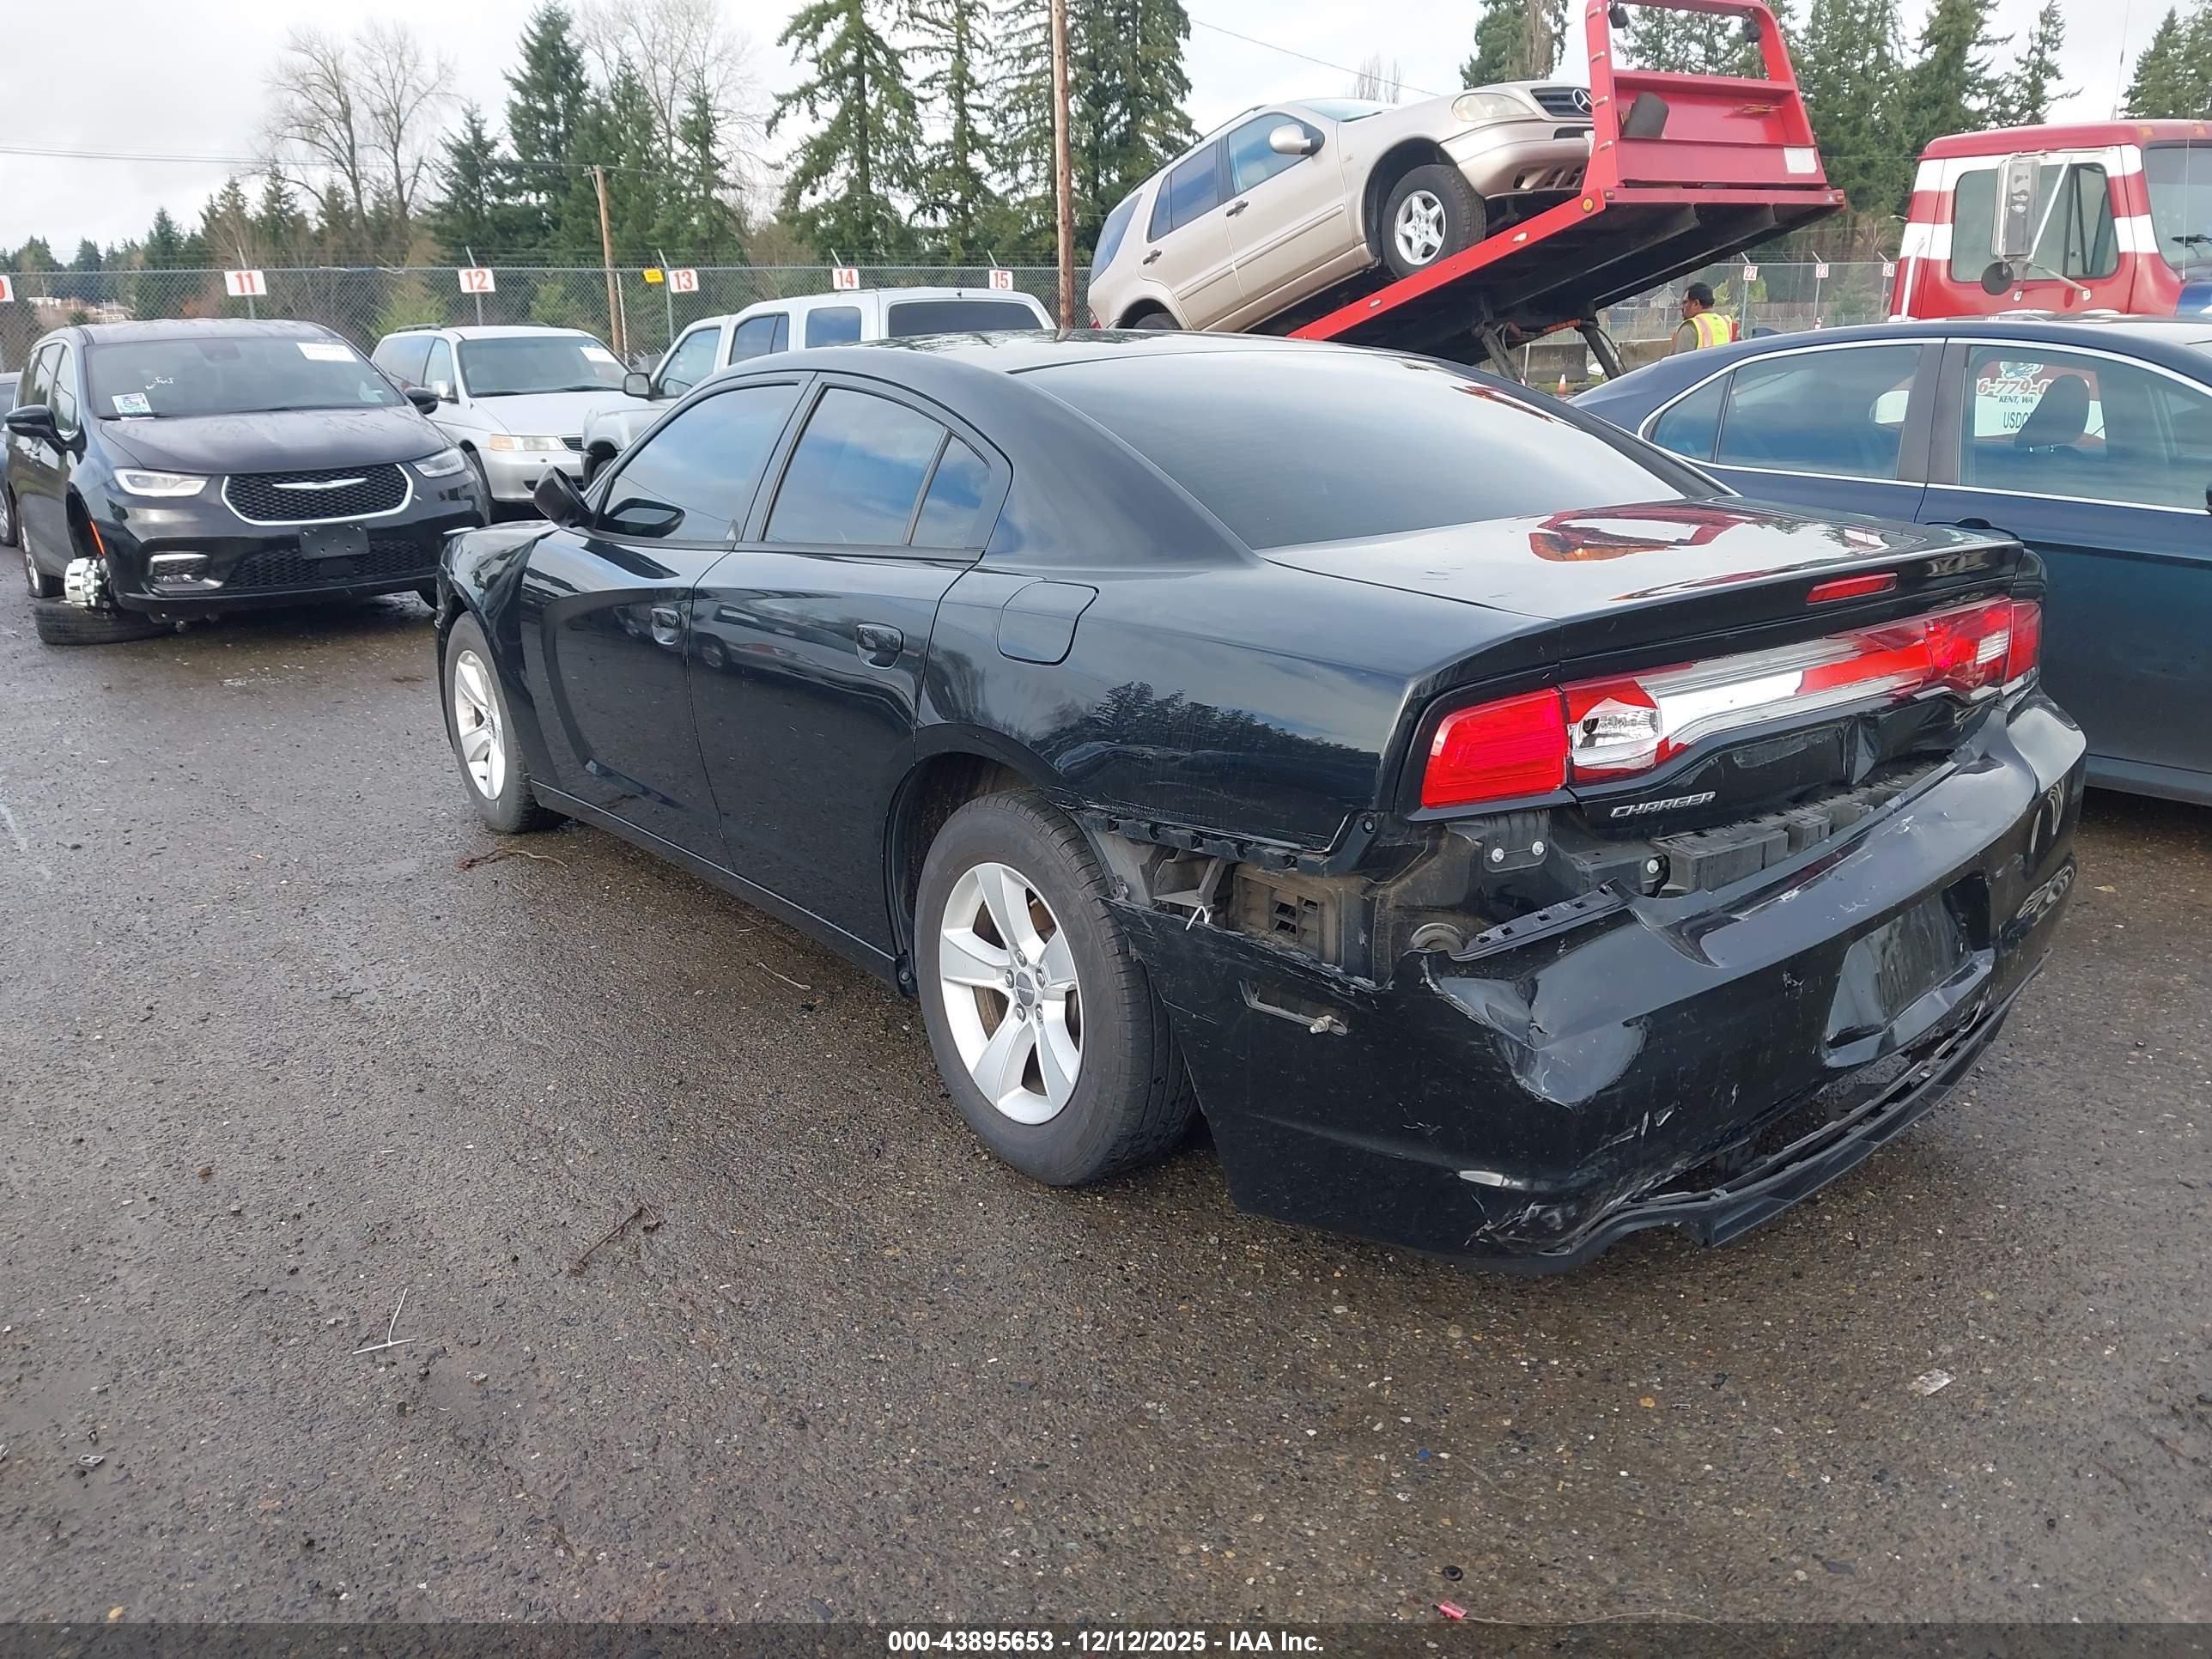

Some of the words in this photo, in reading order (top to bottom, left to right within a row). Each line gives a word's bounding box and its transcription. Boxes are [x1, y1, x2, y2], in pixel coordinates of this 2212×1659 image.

[1745, 266, 1756, 279] 22
[1817, 264, 1827, 276] 23
[1884, 264, 1894, 276] 24
[235, 271, 256, 293] 11
[465, 270, 489, 290] 12
[674, 270, 693, 290] 13
[837, 270, 854, 289] 14
[994, 271, 1009, 289] 15
[1998, 396, 2020, 404] KENT,
[2003, 411, 2032, 428] USDO
[1610, 791, 1717, 818] CHARGER
